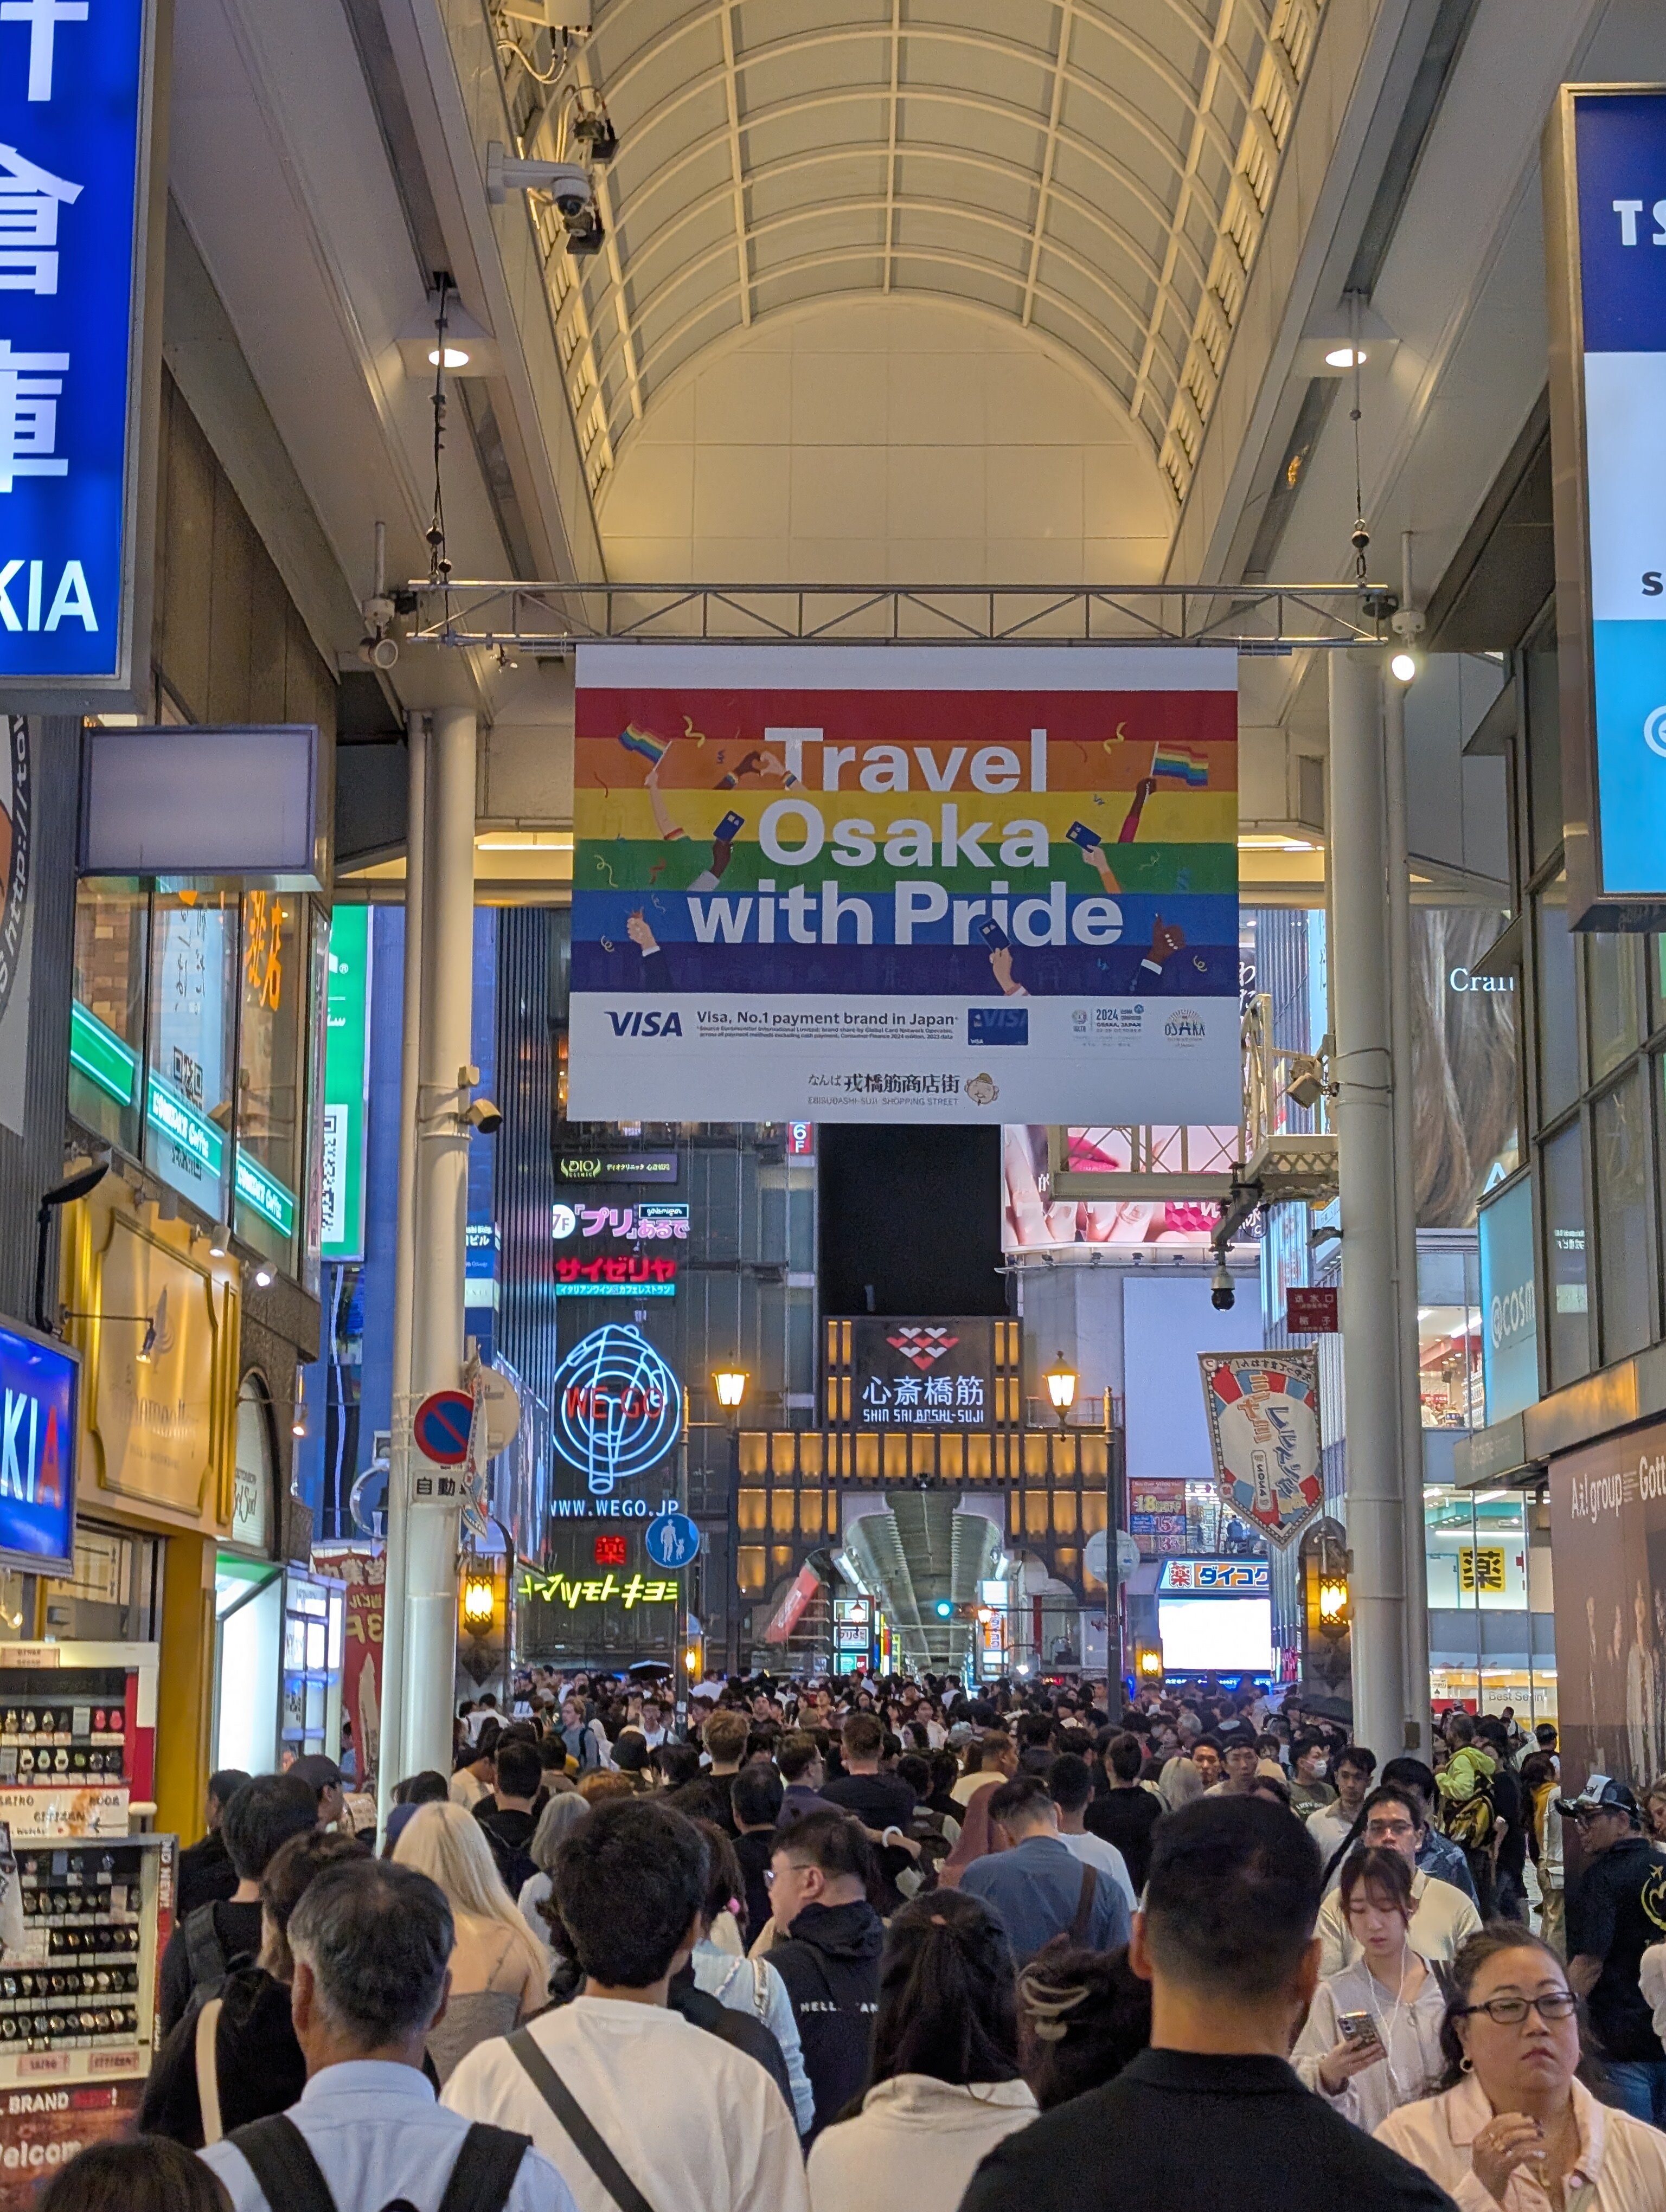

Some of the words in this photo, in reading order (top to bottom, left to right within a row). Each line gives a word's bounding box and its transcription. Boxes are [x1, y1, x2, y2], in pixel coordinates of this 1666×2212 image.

[765, 728, 1047, 794] Travel
[759, 799, 1049, 867] Osaka
[687, 878, 873, 944] with
[894, 880, 1124, 947] Pride
[604, 1011, 683, 1037] VISA
[697, 1011, 732, 1024] Visa,
[738, 1012, 768, 1024] No.1
[772, 1012, 840, 1027] payment
[844, 1012, 888, 1025] brand
[893, 1012, 906, 1025] in
[1096, 1008, 1118, 1021] 2024
[808, 1074, 841, 1086] なんば
[843, 1073, 960, 1094] 戎橋筋商店街
[882, 1097, 925, 1105] SHOPPING
[928, 1097, 959, 1105] STREET
[569, 1160, 594, 1173] DIO
[556, 1256, 677, 1283] サイゼリヤ
[862, 1375, 984, 1406] 心斎橋筋
[863, 1409, 889, 1423] SHIN
[1590, 1473, 1623, 1524] group
[1169, 1561, 1192, 1588] 薬
[1463, 1550, 1502, 1589] 薬
[9, 2091, 69, 2115] BRAND
